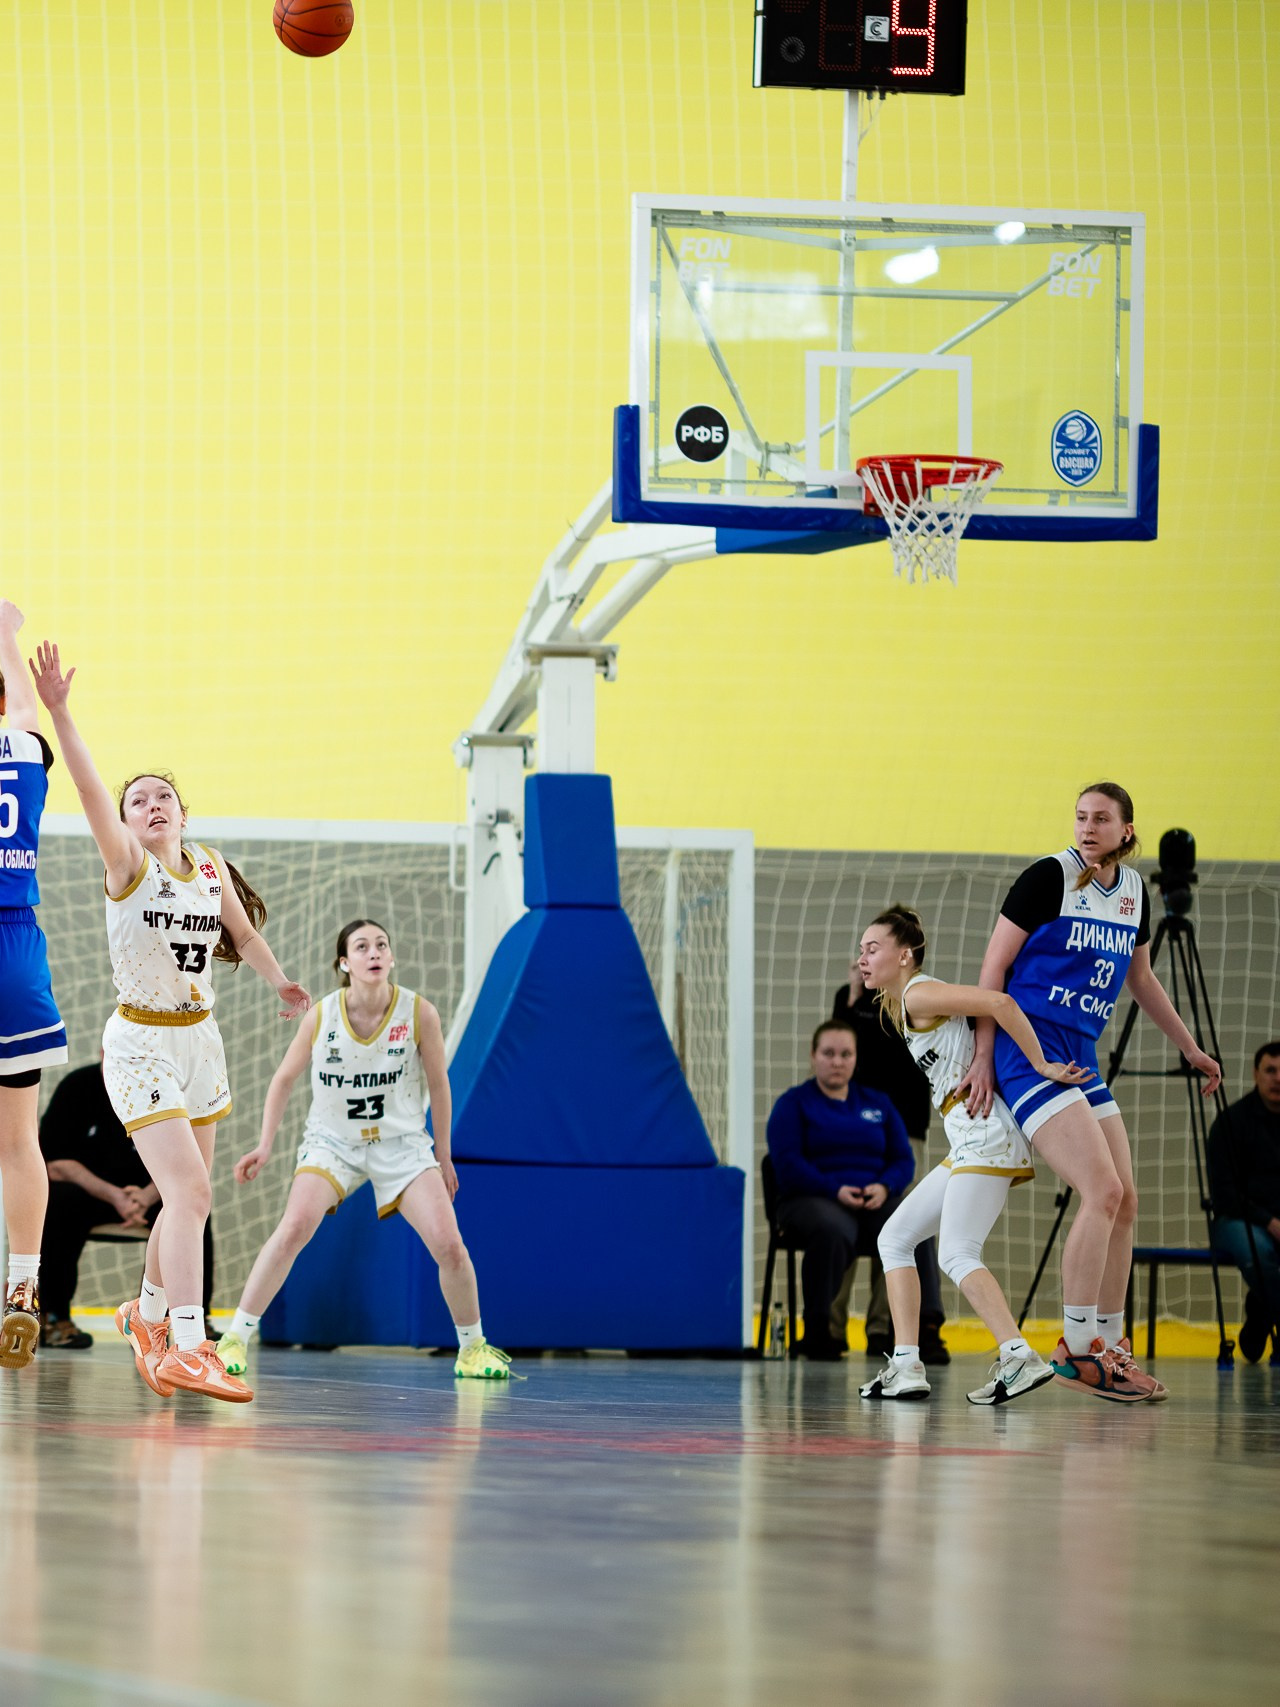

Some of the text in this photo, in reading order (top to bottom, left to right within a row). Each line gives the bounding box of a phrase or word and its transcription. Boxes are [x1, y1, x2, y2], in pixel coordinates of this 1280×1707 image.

[681, 237, 732, 259] FON
[679, 261, 730, 281] BET
[1048, 252, 1102, 275] FON
[1047, 276, 1102, 299] BET
[681, 425, 725, 443] РФБ
[5, 849, 37, 869] ОБЛАСТЬ
[143, 910, 221, 932] ЧГУ-АТЛАН
[1066, 920, 1136, 958] ДИНАМО
[1089, 959, 1115, 989] 33
[1048, 985, 1114, 1020] ГК СМС
[346, 1094, 385, 1120] 23
